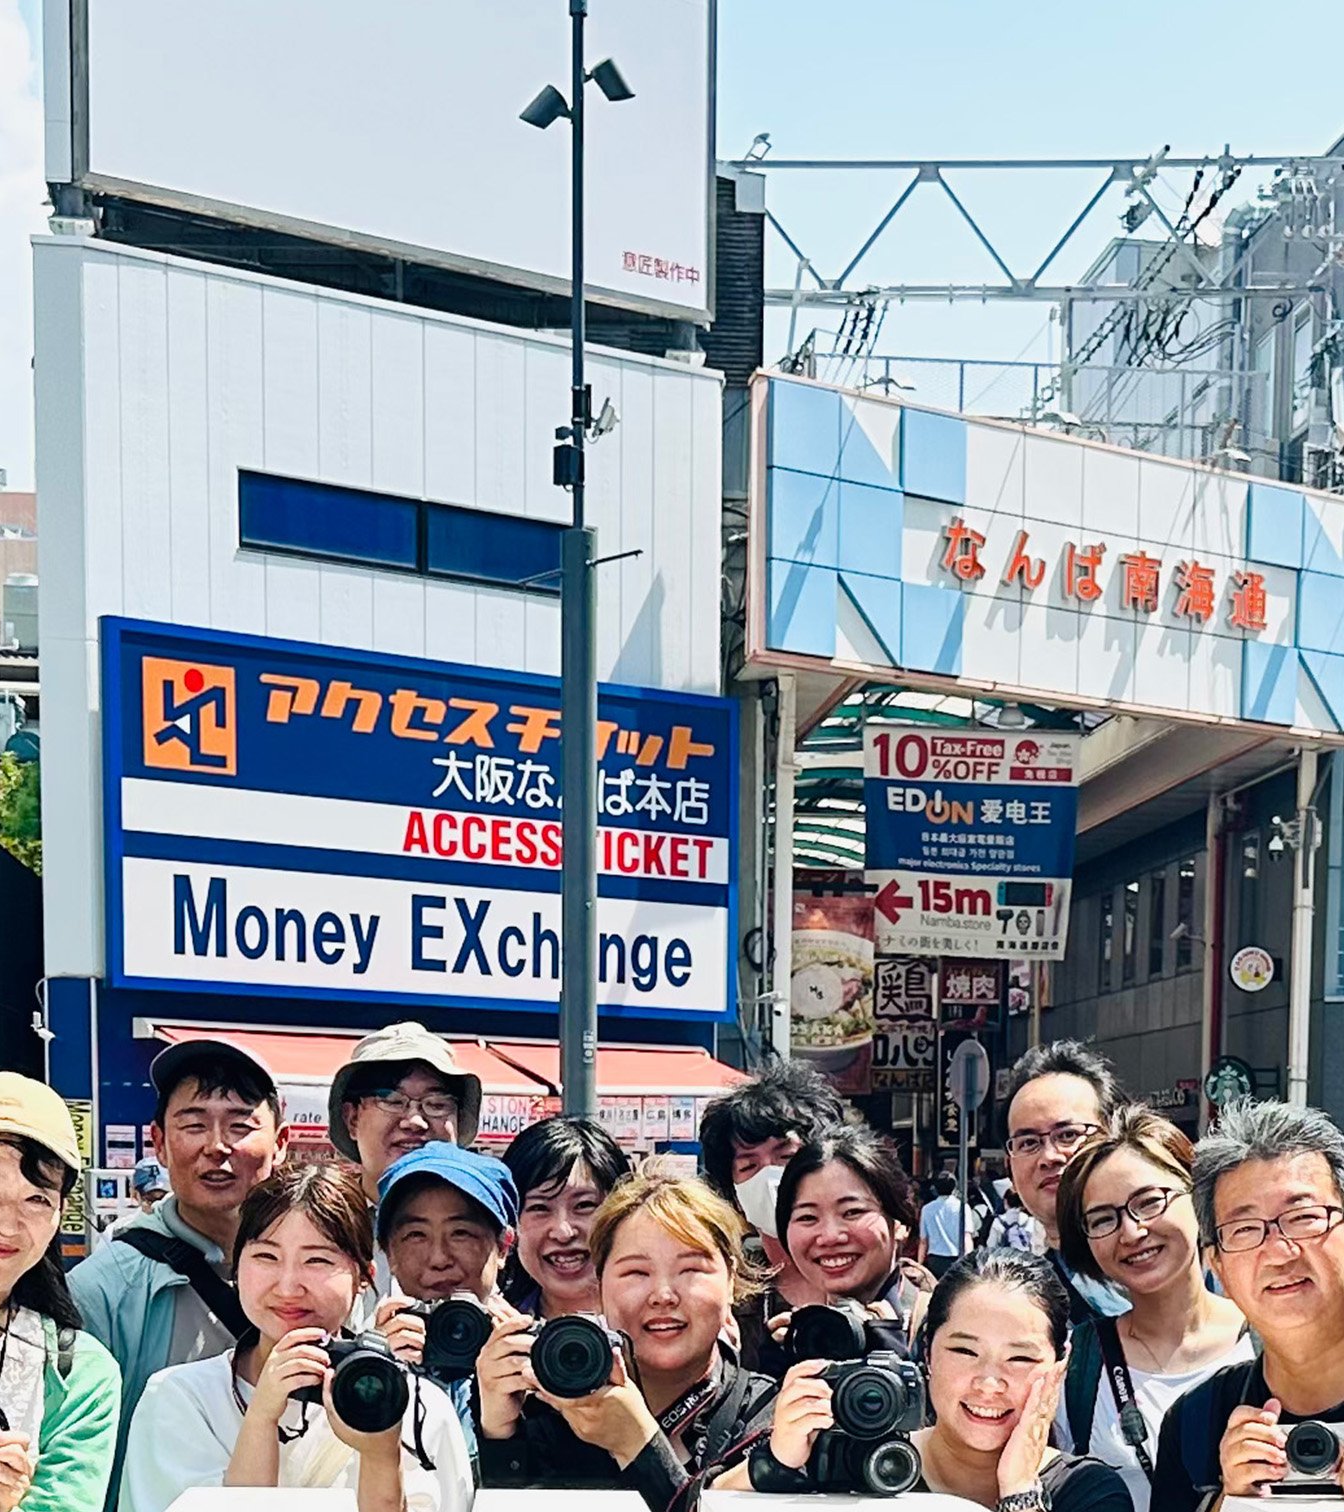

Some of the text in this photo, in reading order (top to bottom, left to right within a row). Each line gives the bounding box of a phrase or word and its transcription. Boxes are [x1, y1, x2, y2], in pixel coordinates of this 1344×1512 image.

[941, 515, 1269, 633] なんば南海通
[872, 732, 930, 779] 10
[932, 739, 1005, 757] Tax-Free
[432, 750, 711, 826] 大阪なば本店
[932, 759, 1001, 781] %OFF
[886, 785, 1053, 826] EDION 爱电王
[402, 810, 714, 880] ACCESS ICKET
[917, 879, 992, 916] 15m
[172, 873, 694, 993] Money EXchnge
[946, 972, 997, 1000] 焼肉
[293, 1111, 322, 1124] rate
[482, 1116, 526, 1133] HANGE
[661, 1404, 687, 1429] EOS
